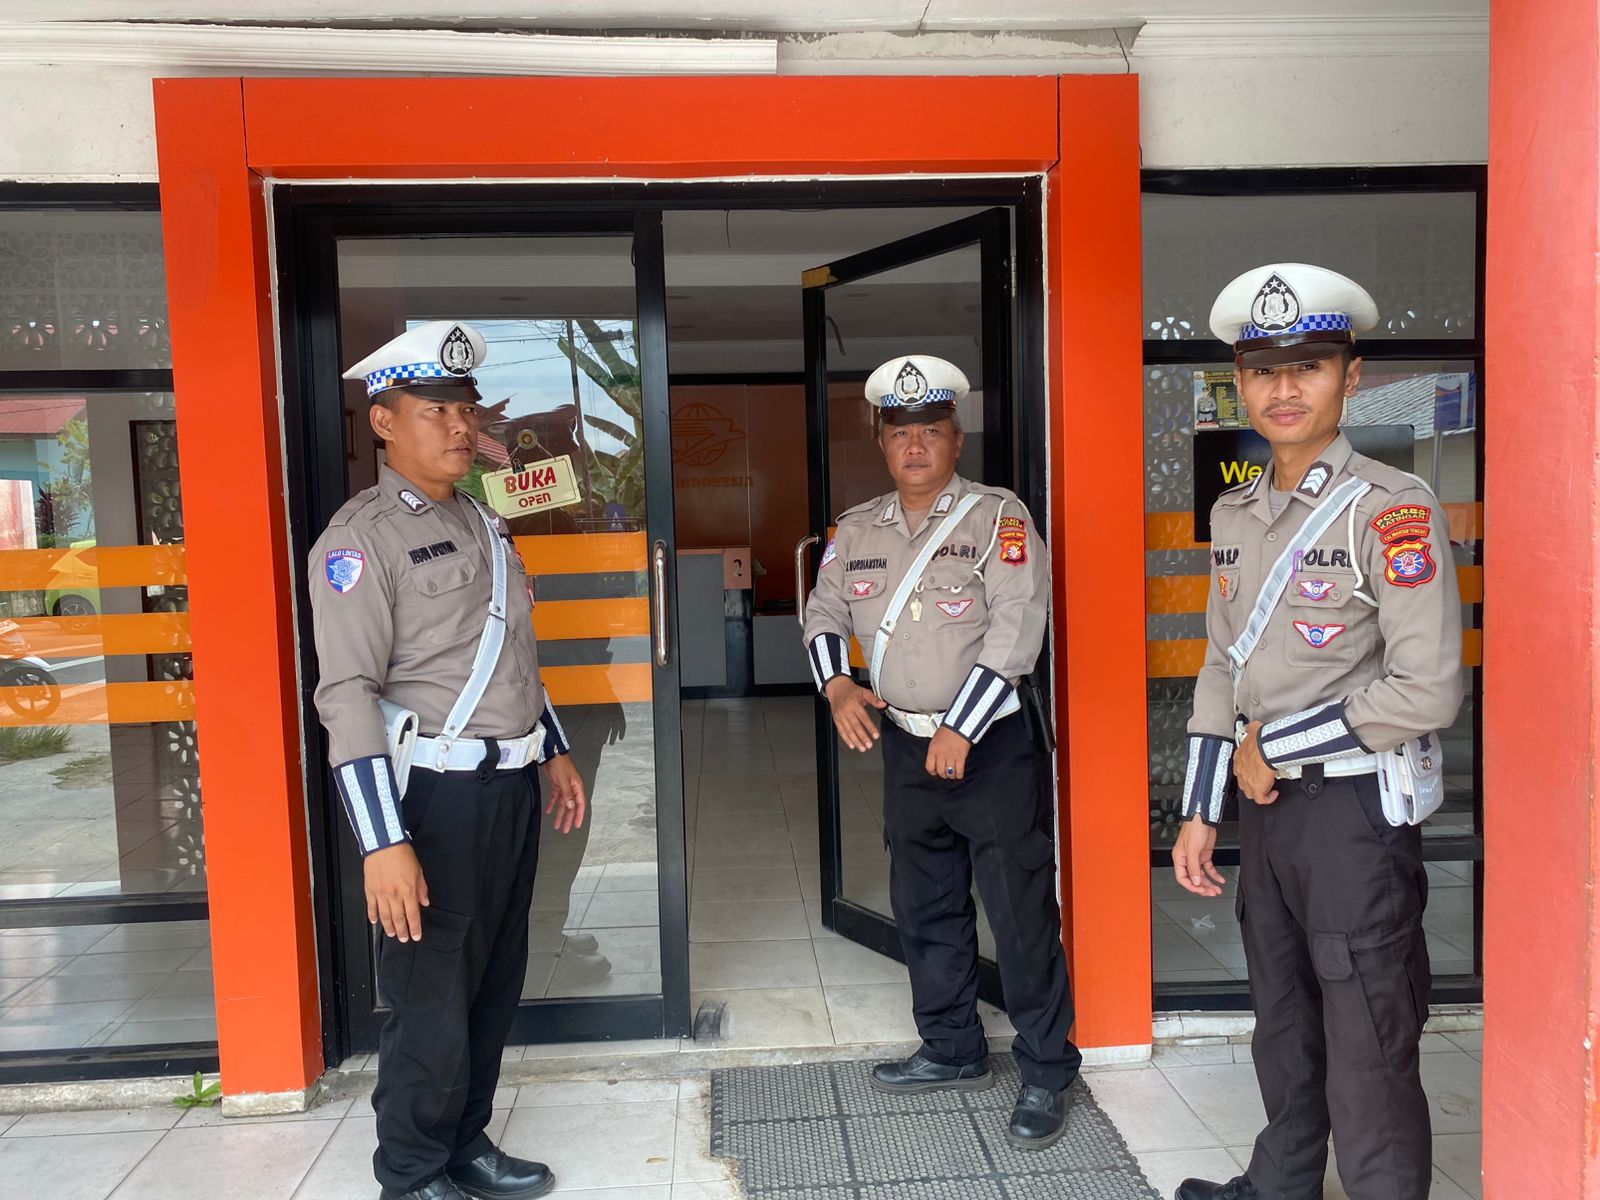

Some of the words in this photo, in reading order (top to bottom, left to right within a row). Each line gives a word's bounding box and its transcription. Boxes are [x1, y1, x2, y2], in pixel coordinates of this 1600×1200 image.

[504, 466, 556, 494] BUKA
[518, 492, 552, 508] OPEN
[1376, 508, 1426, 526] POLRES
[1379, 514, 1425, 529] KATINGAN
[328, 550, 342, 558] LALU
[342, 550, 362, 559] LINTAS
